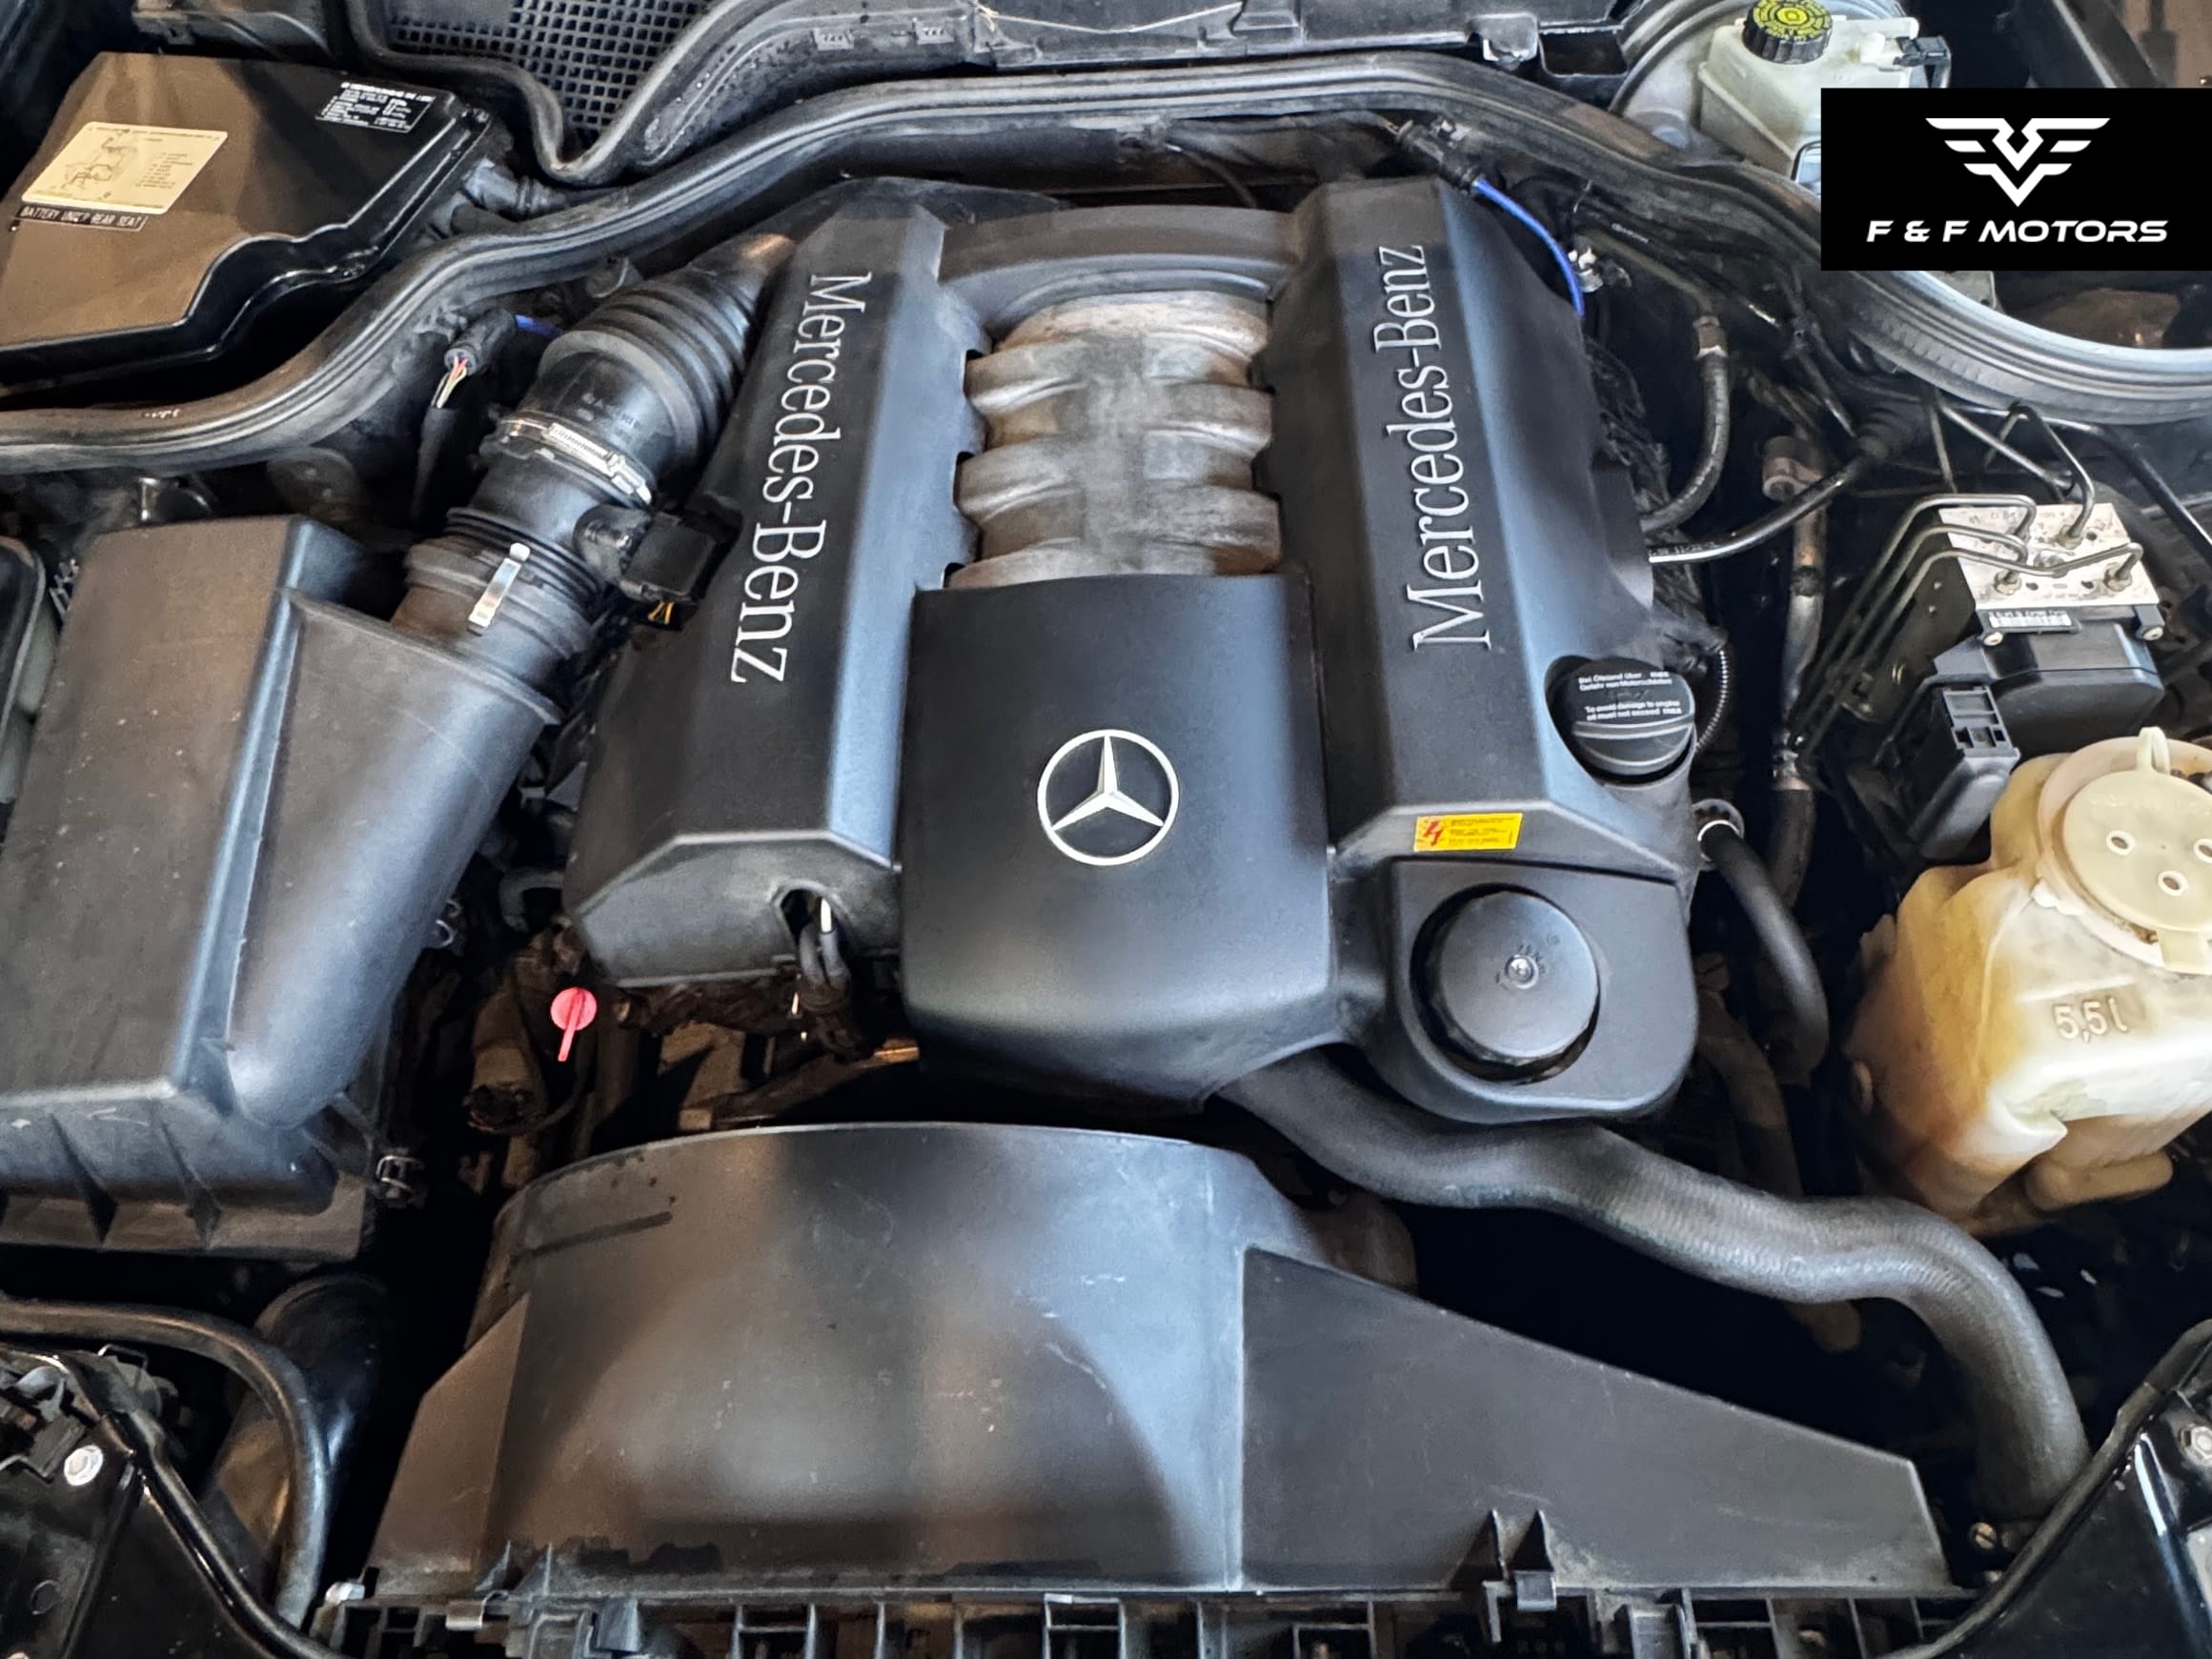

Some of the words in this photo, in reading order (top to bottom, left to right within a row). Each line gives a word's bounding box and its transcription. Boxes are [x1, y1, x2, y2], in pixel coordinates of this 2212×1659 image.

[20, 206, 60, 219] BATTERY
[91, 212, 116, 225] REAR
[116, 214, 141, 228] SEAT
[730, 272, 873, 684] Mercedes-Benz
[1371, 245, 1492, 652] Mercedes-Benz
